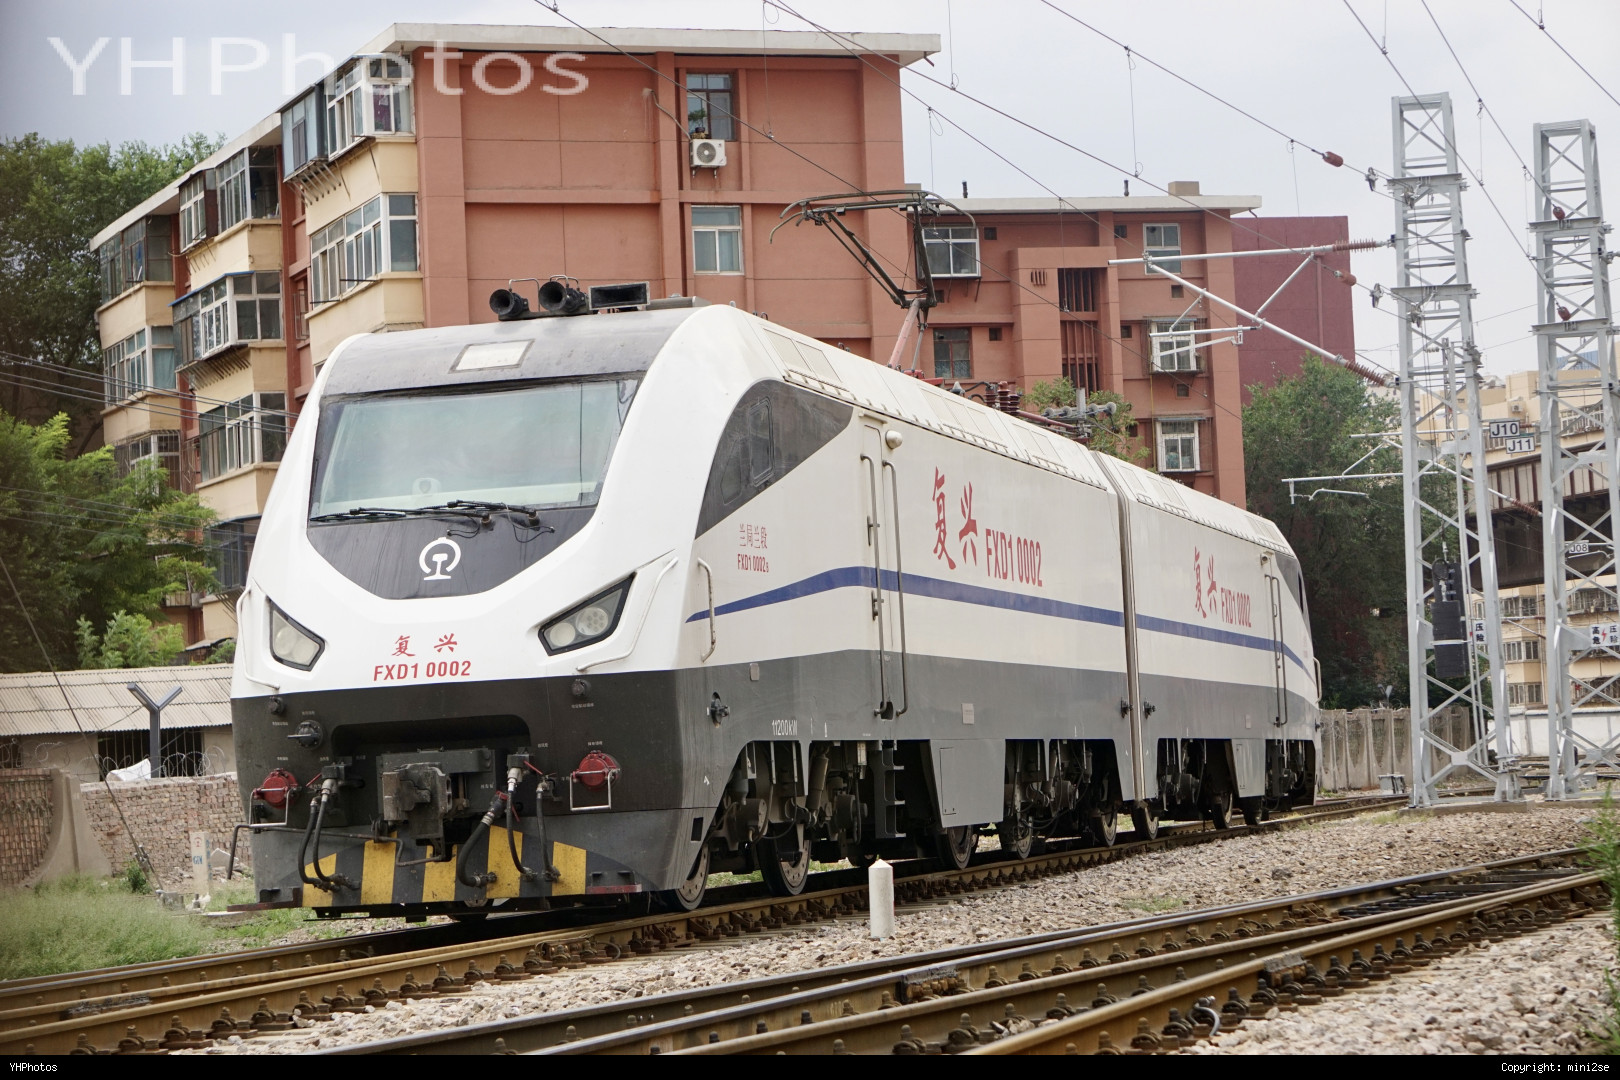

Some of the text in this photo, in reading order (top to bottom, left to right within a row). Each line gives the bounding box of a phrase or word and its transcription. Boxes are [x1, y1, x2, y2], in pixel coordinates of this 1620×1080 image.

[1491, 422, 1518, 437] J10
[1508, 438, 1532, 452] J11
[932, 465, 978, 570] 复兴
[985, 528, 1043, 587] FXD1 0002
[1570, 543, 1588, 553] J08
[391, 633, 458, 657] 复兴
[373, 660, 471, 682] FXD1 0002
